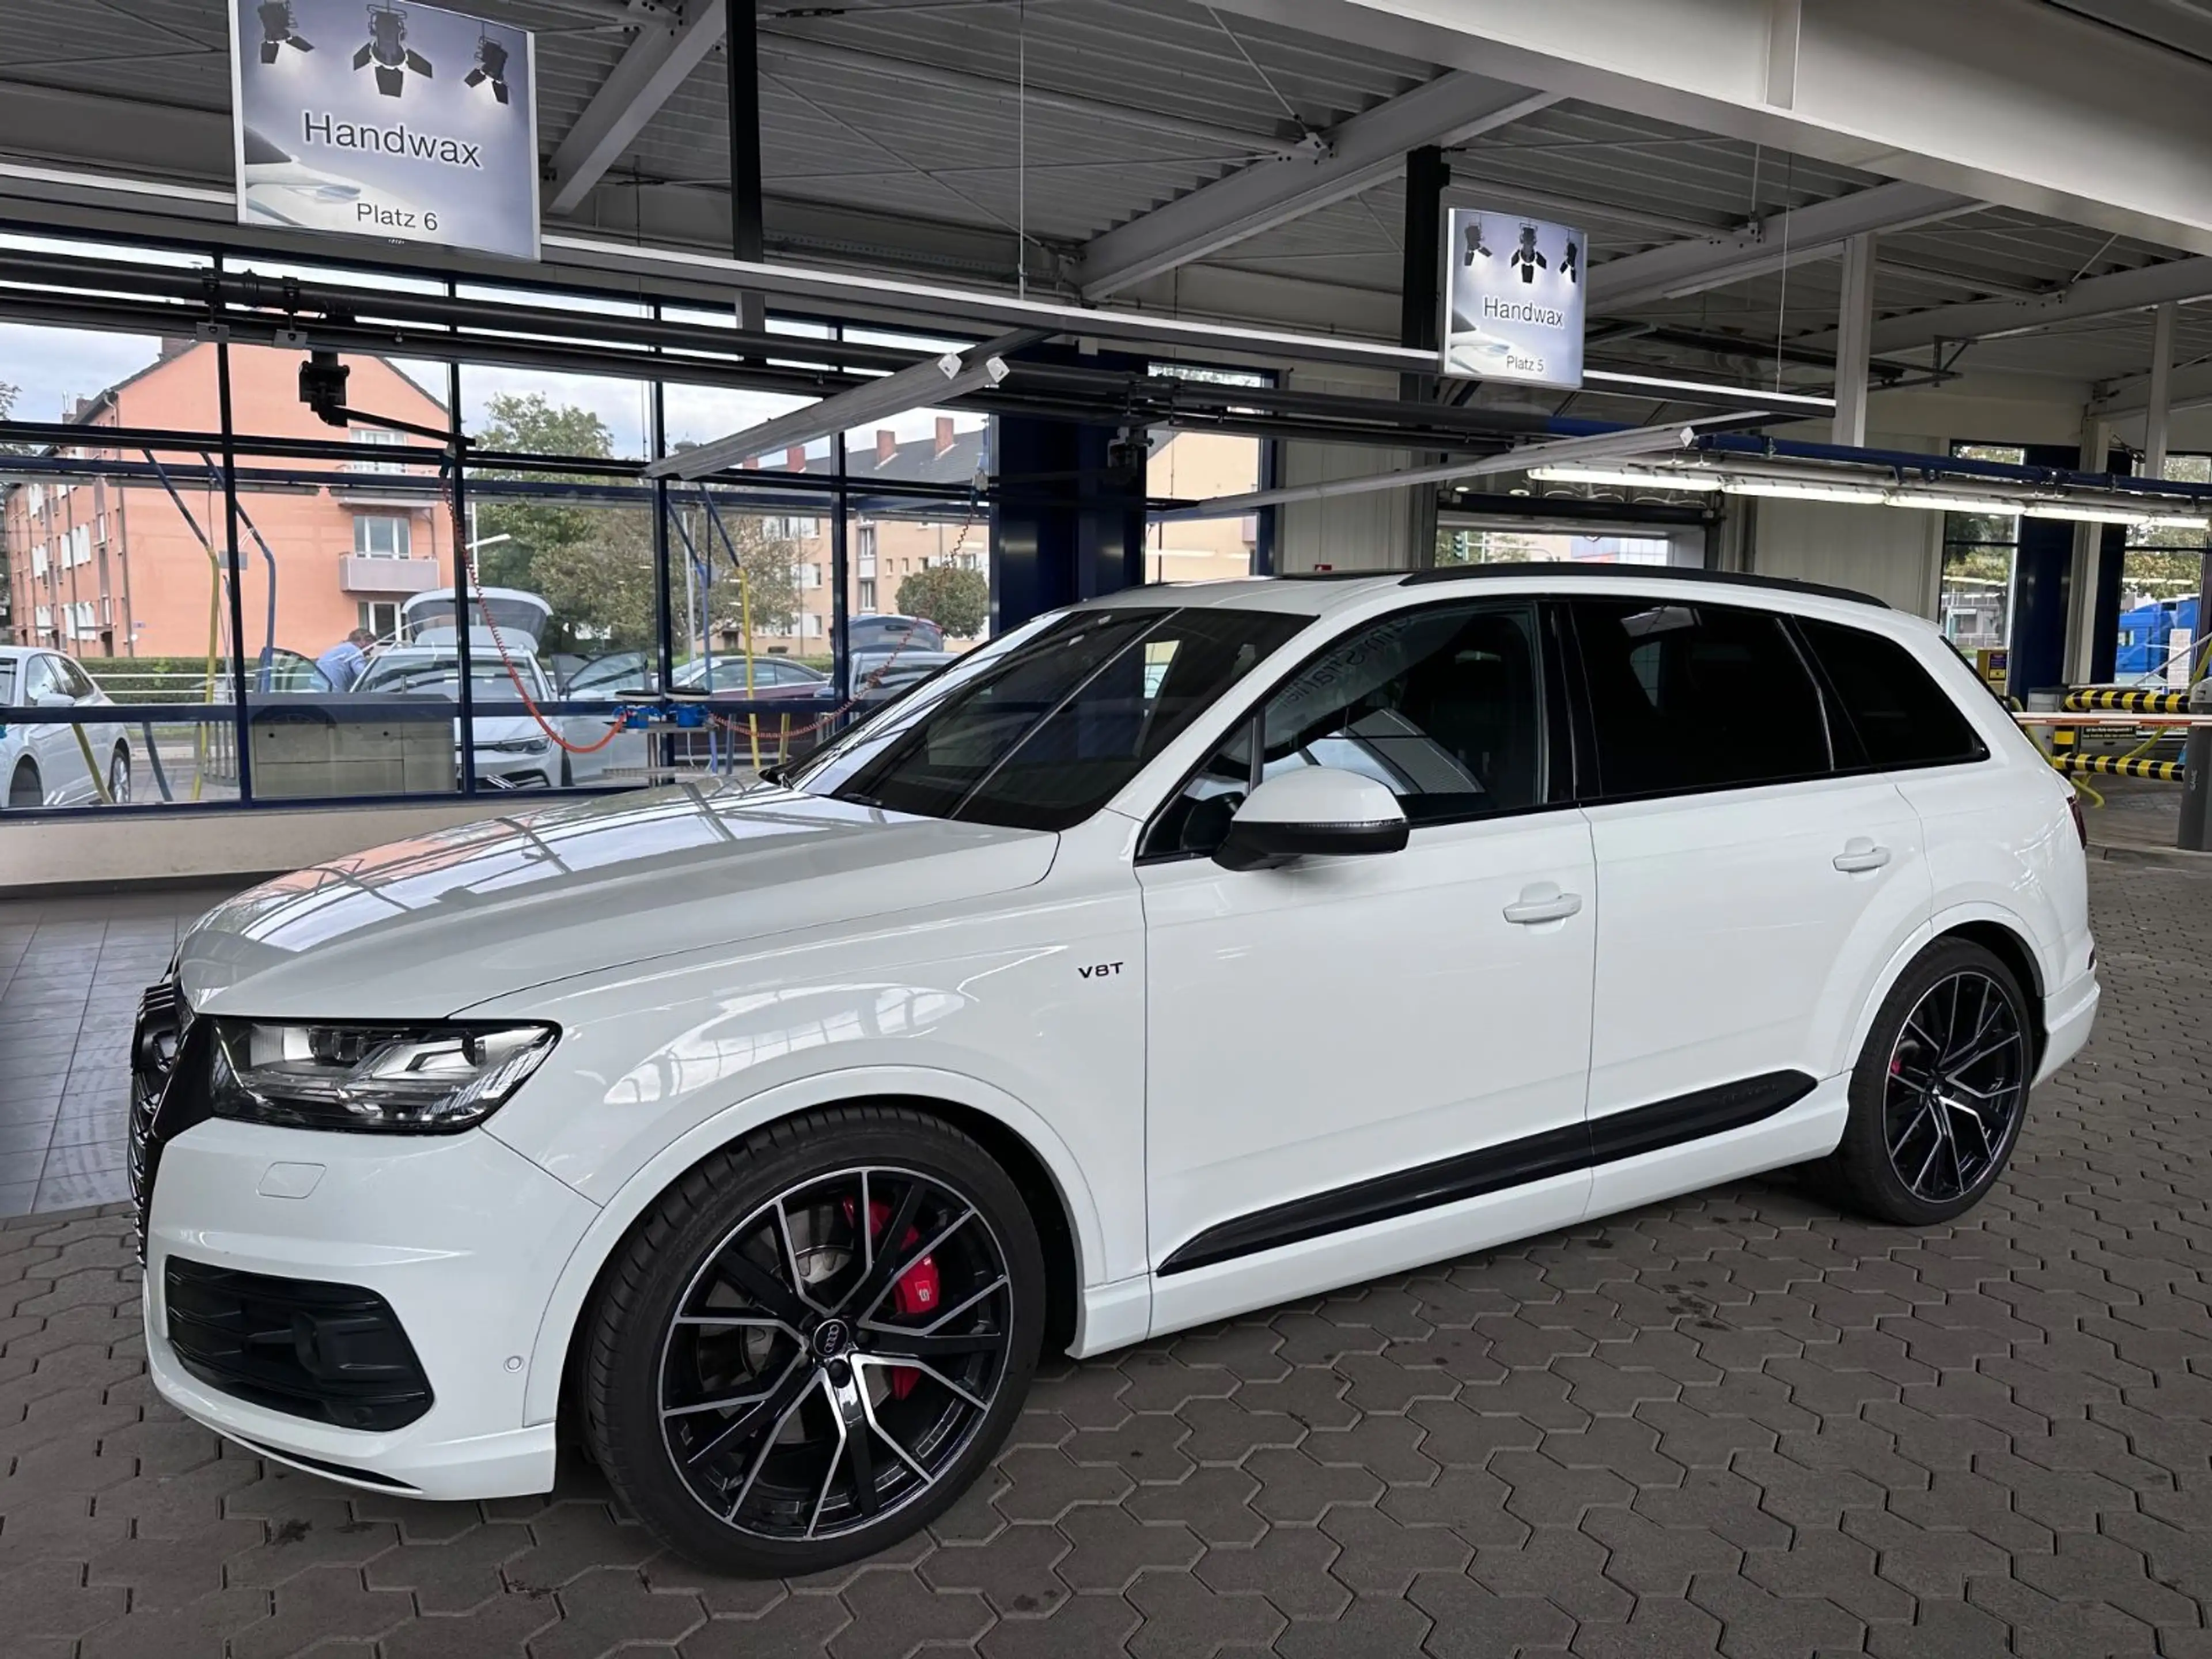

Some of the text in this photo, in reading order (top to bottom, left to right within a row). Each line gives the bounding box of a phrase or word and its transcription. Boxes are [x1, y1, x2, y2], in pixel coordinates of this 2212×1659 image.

[305, 112, 482, 168] Handwax
[357, 203, 438, 230] Platz 6
[1484, 297, 1563, 327] Handwax
[1506, 355, 1544, 372] Platz 5
[1078, 962, 1123, 979] V8T
